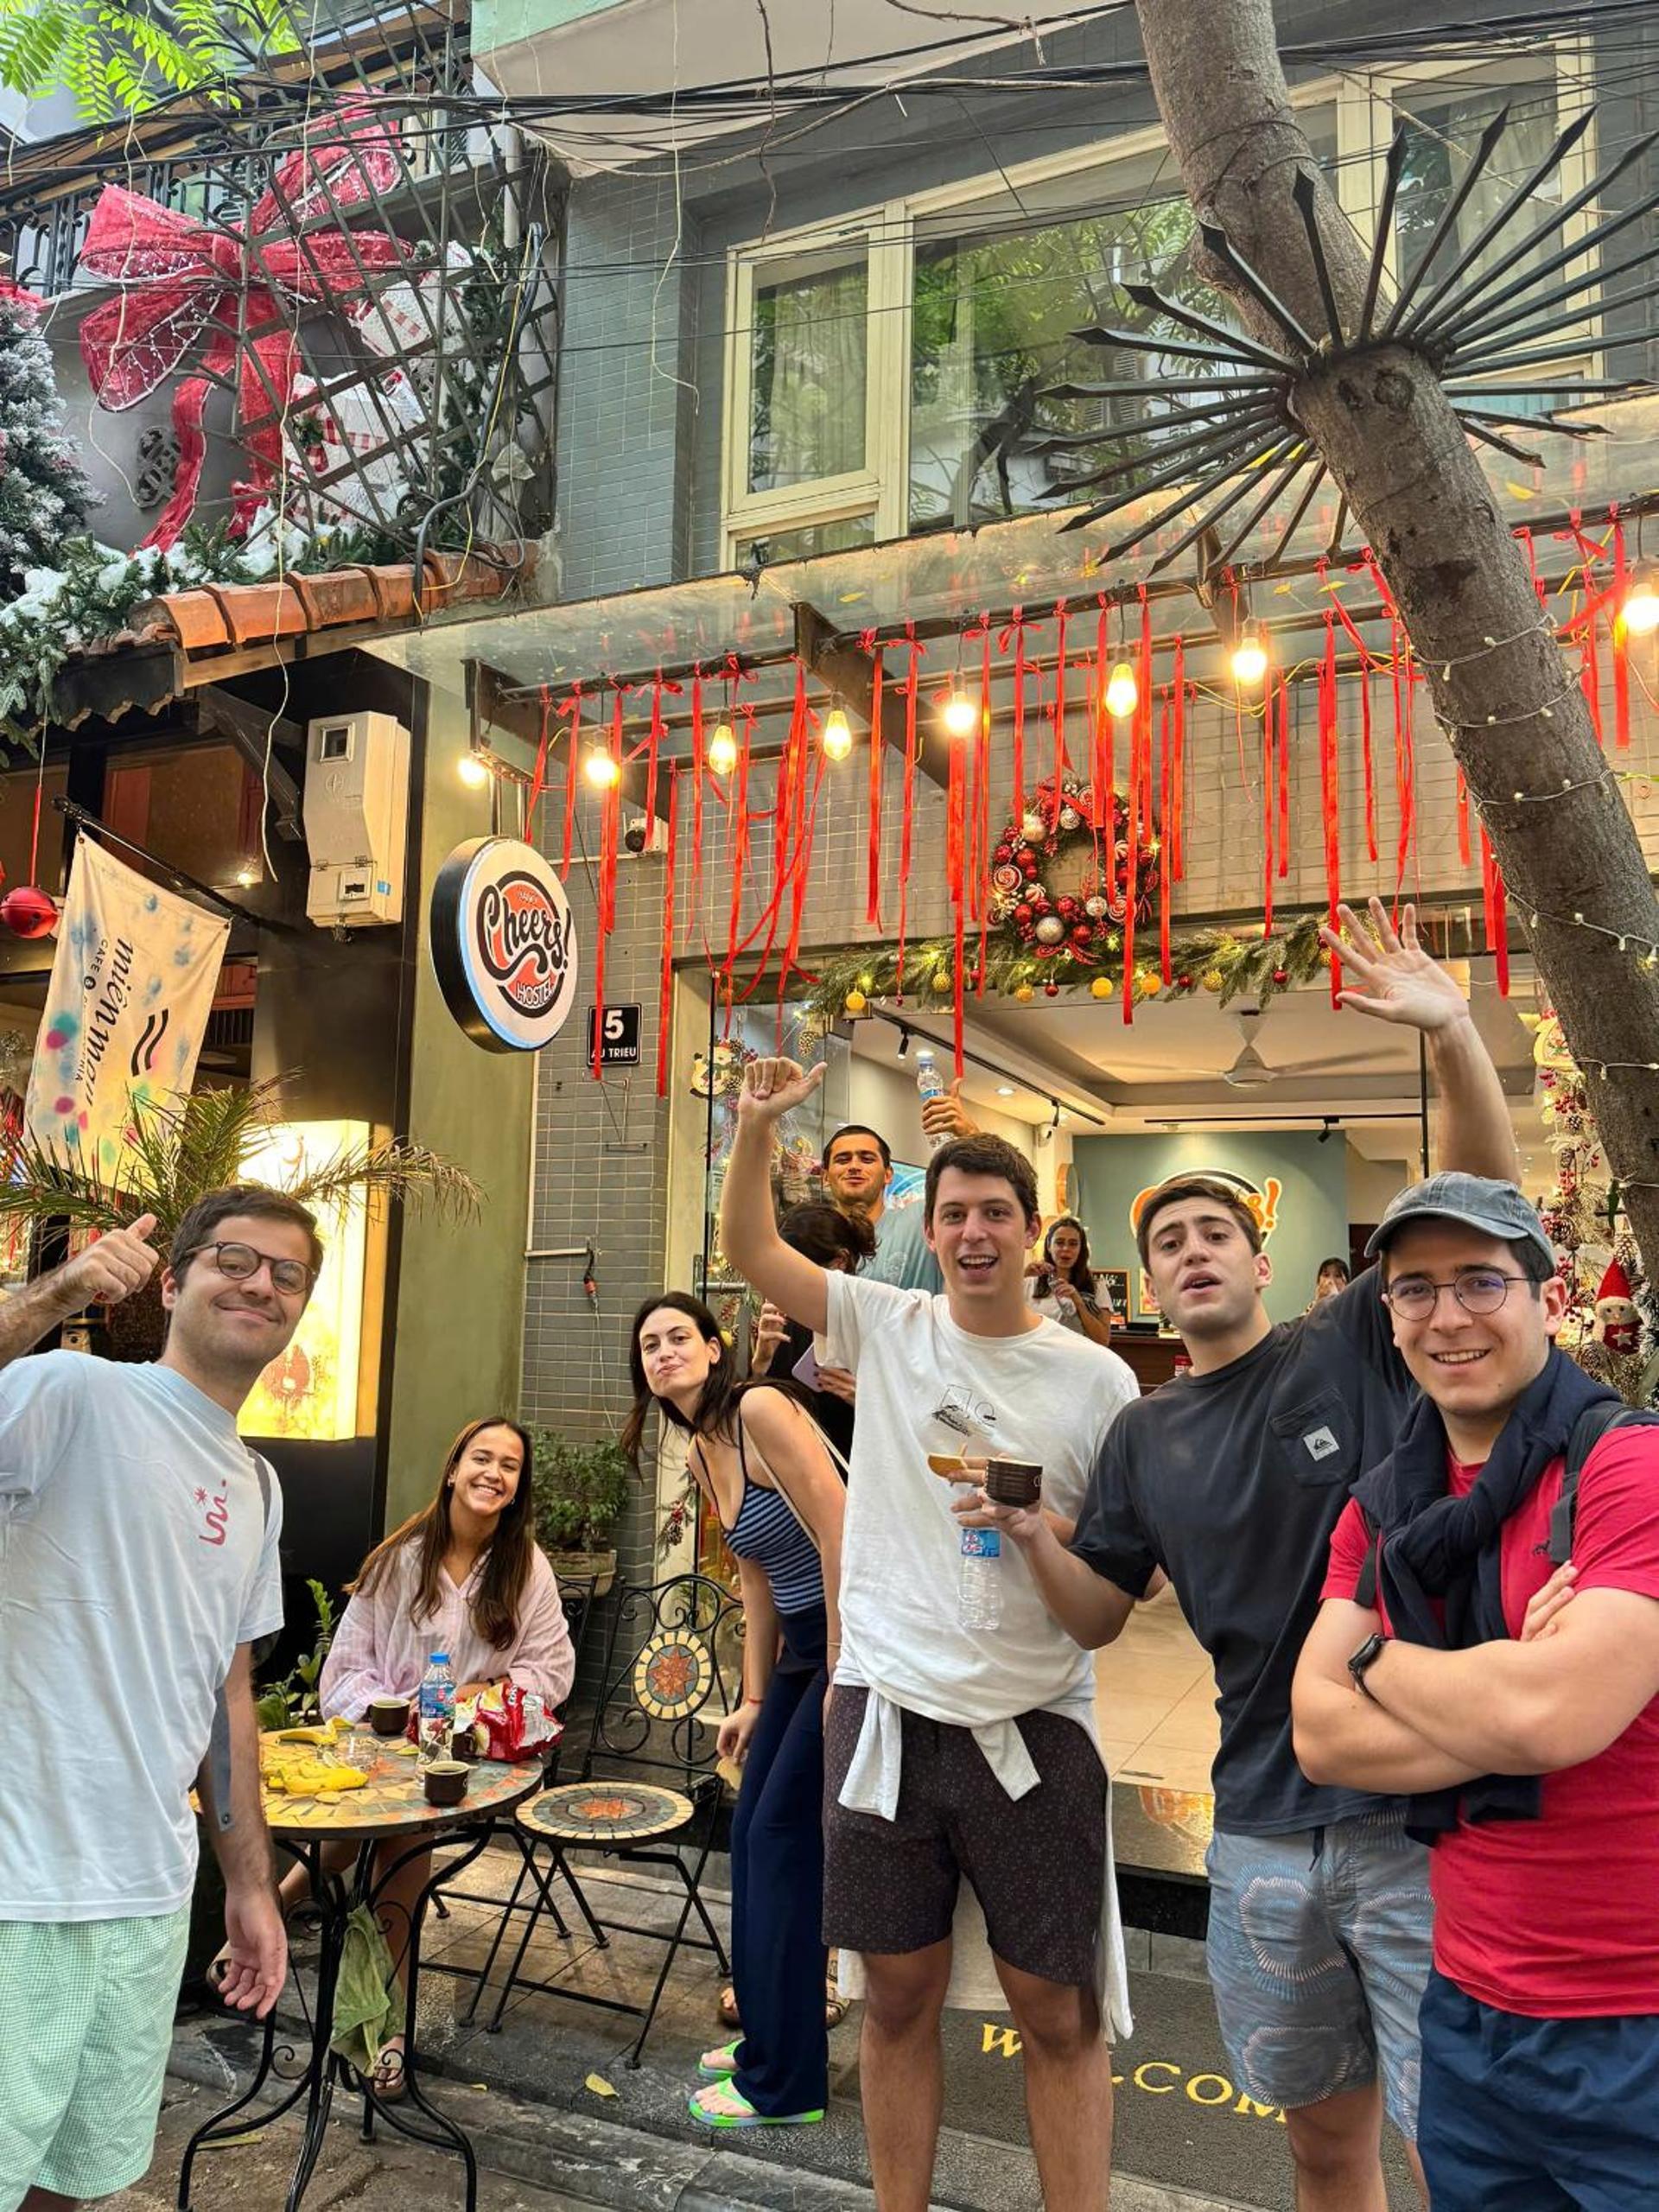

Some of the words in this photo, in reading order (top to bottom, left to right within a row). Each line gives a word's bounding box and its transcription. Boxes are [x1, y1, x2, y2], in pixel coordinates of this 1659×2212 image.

[476, 884, 572, 980] Cheers!
[604, 1009, 625, 1039] 5
[608, 1046, 637, 1058] TRIEU
